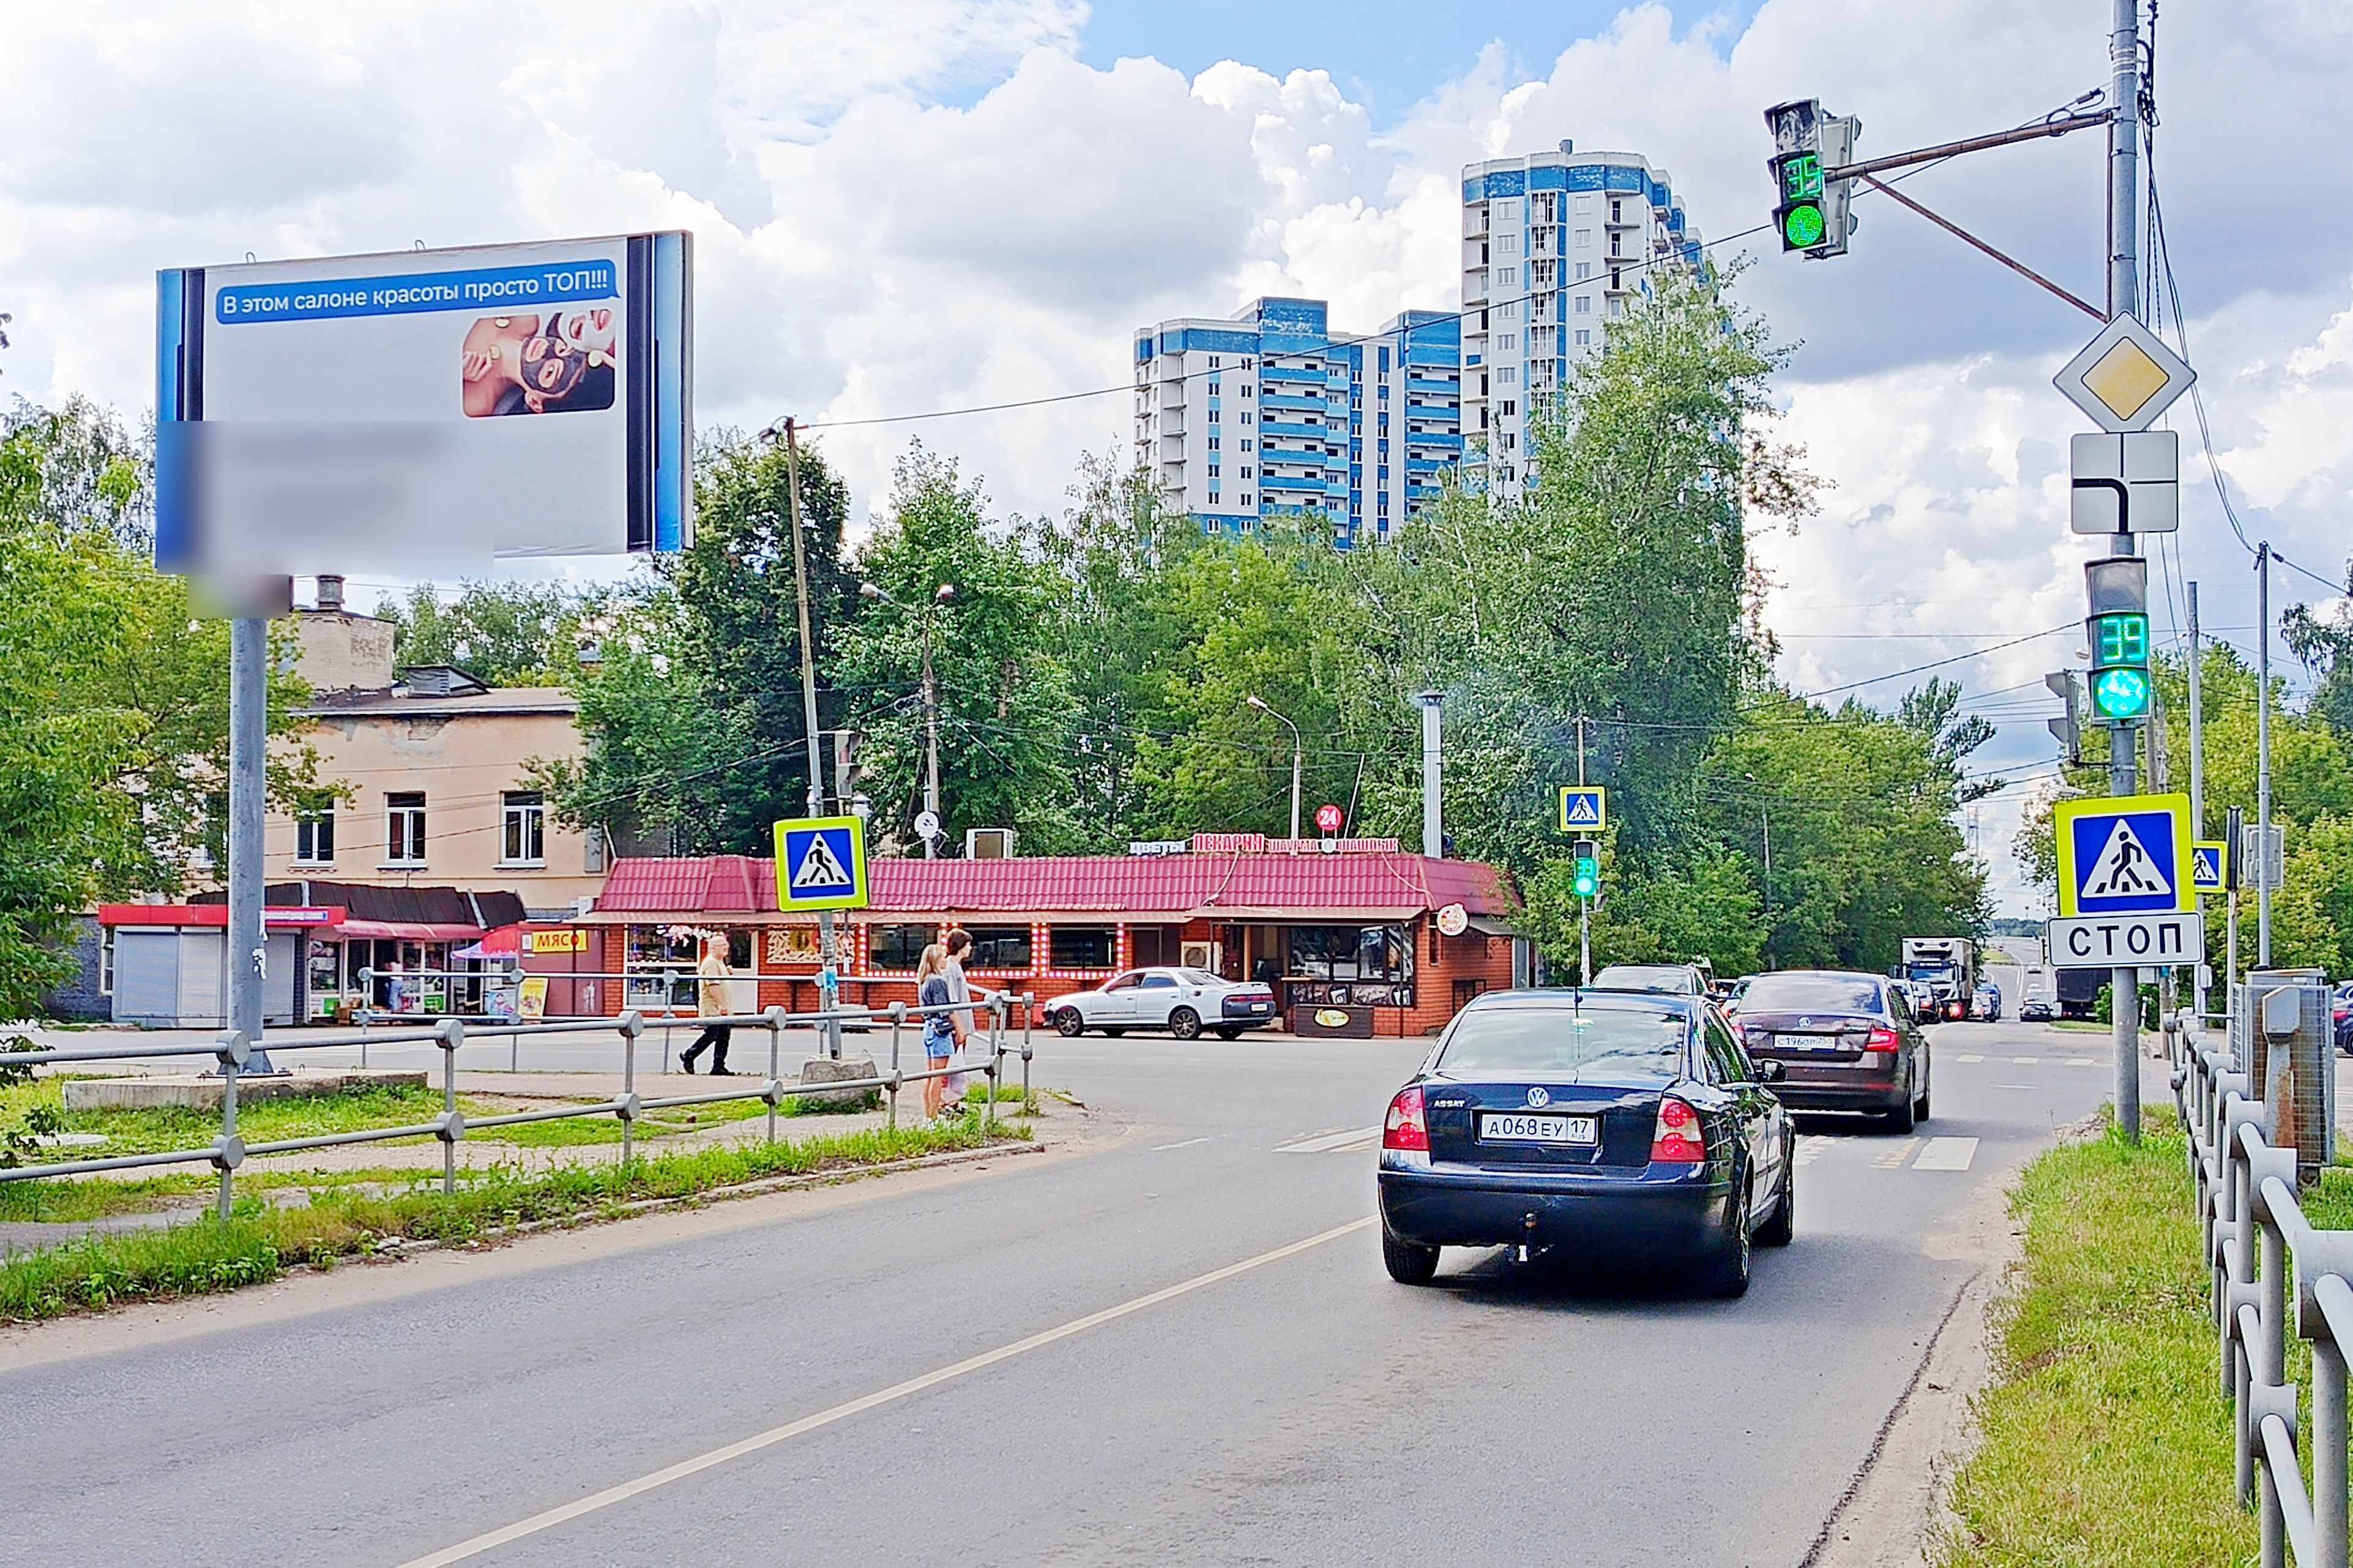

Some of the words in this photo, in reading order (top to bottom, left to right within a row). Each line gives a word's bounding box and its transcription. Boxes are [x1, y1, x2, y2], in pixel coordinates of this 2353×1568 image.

[223, 295, 237, 314] В
[241, 295, 289, 313] этом
[294, 290, 367, 309] салоне
[372, 284, 459, 308] красоты
[464, 279, 539, 302] просто
[544, 269, 608, 292] ТОП!!!
[2101, 617, 2146, 661] 39
[1320, 809, 1338, 825] 24
[1130, 841, 1186, 856] ЦВЕТЫ
[1193, 833, 1264, 852] ПЕКАРНЯ
[2068, 923, 2182, 957] СТОП
[1570, 1120, 1588, 1133] 17
